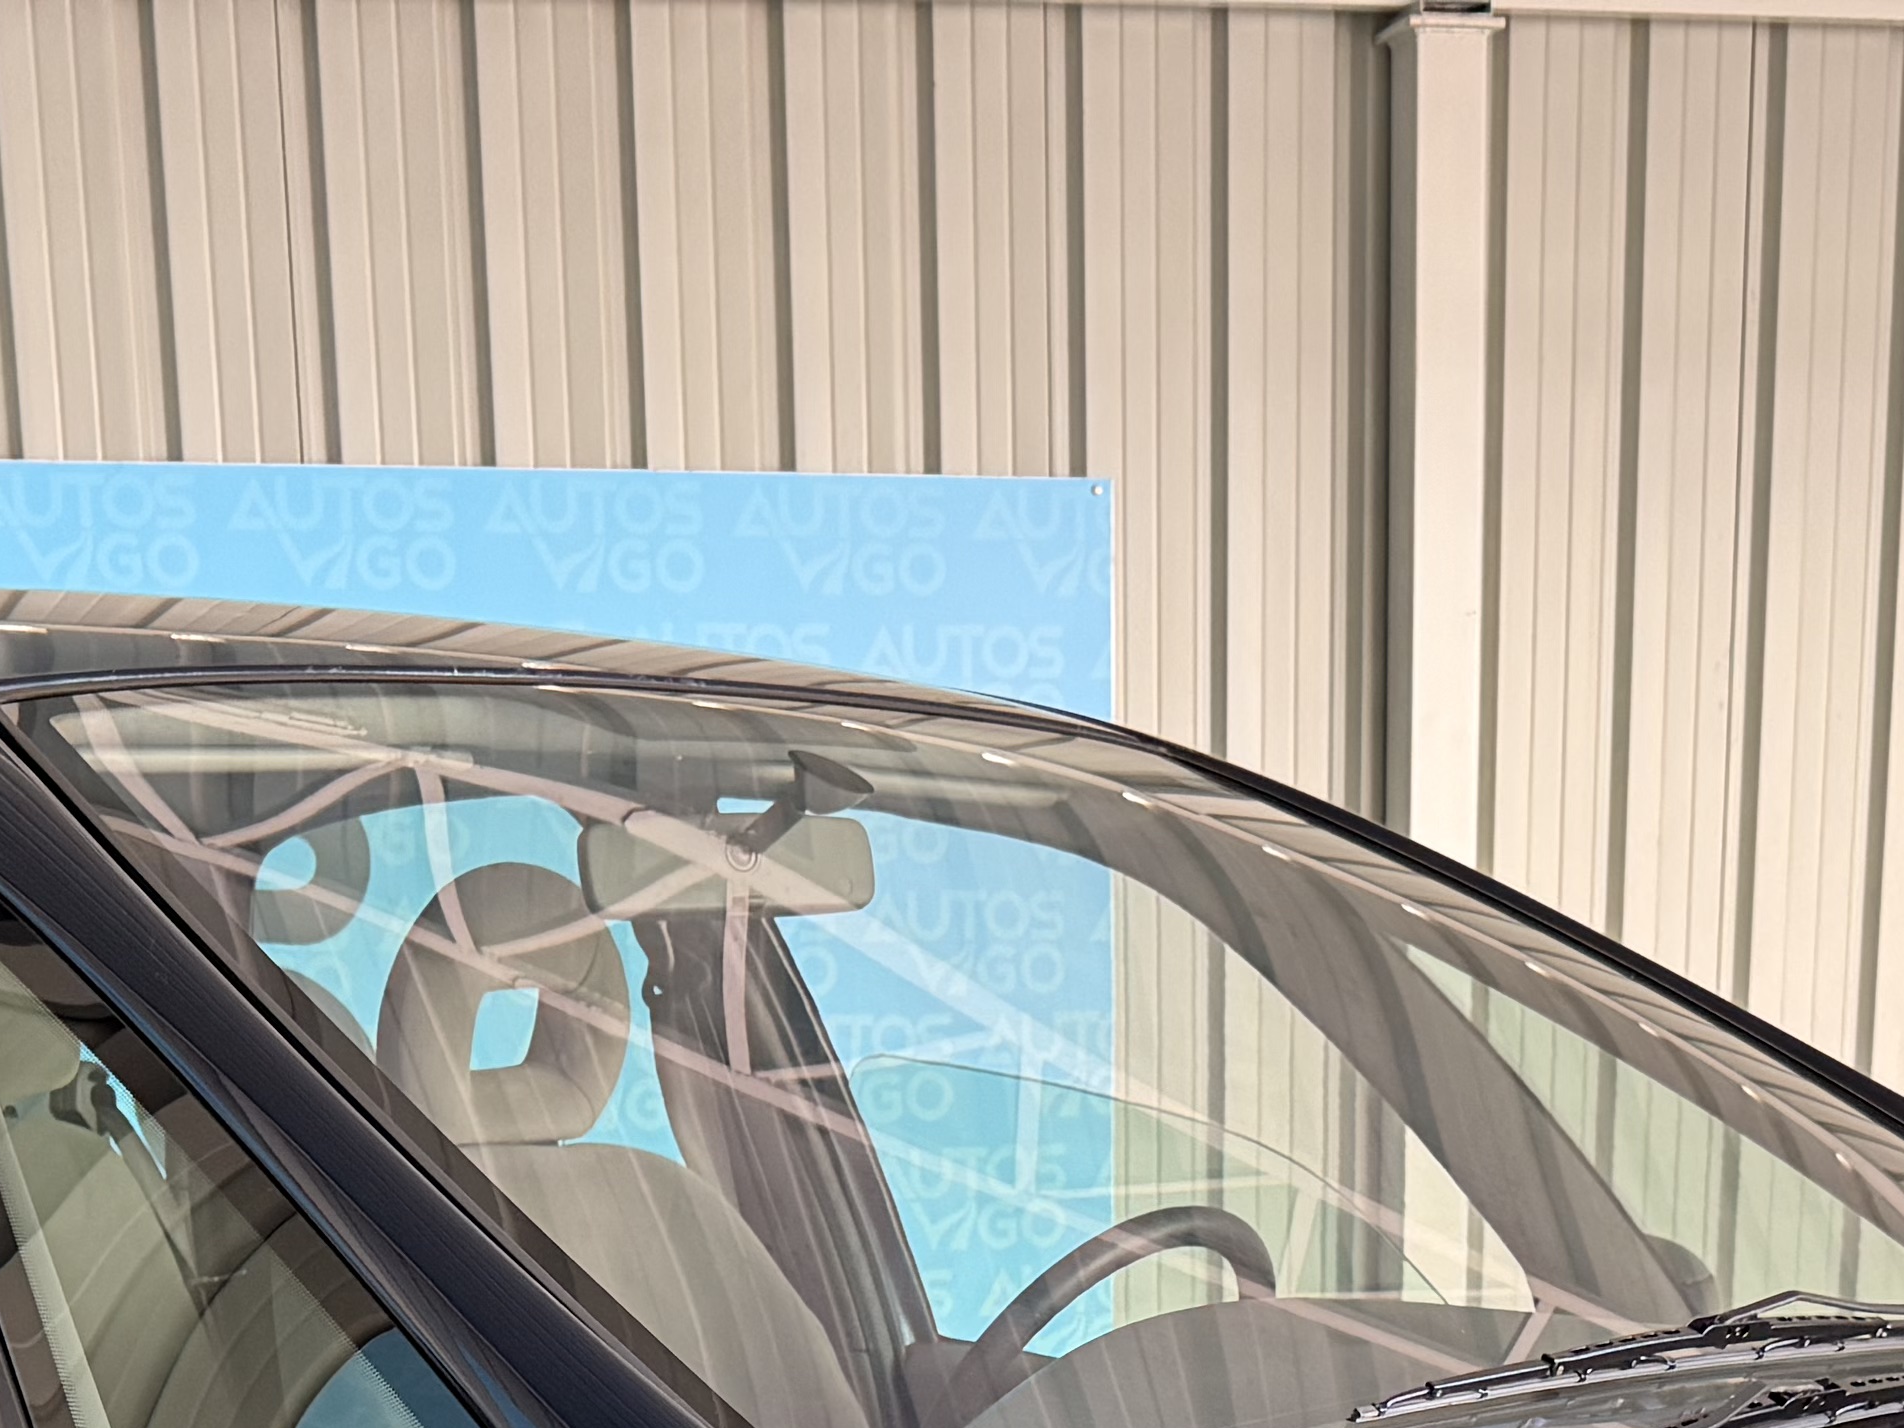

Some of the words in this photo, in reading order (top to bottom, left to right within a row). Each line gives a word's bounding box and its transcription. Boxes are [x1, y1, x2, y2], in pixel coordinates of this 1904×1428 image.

[230, 475, 455, 532] AUTOS
[484, 479, 704, 535] AUTOS
[732, 484, 945, 540] AUTOS
[12, 526, 200, 588] VIGO
[276, 529, 457, 591] VIGO
[530, 532, 705, 593] VIGO
[780, 537, 947, 597] VIGO
[864, 623, 1065, 682] AUTOS
